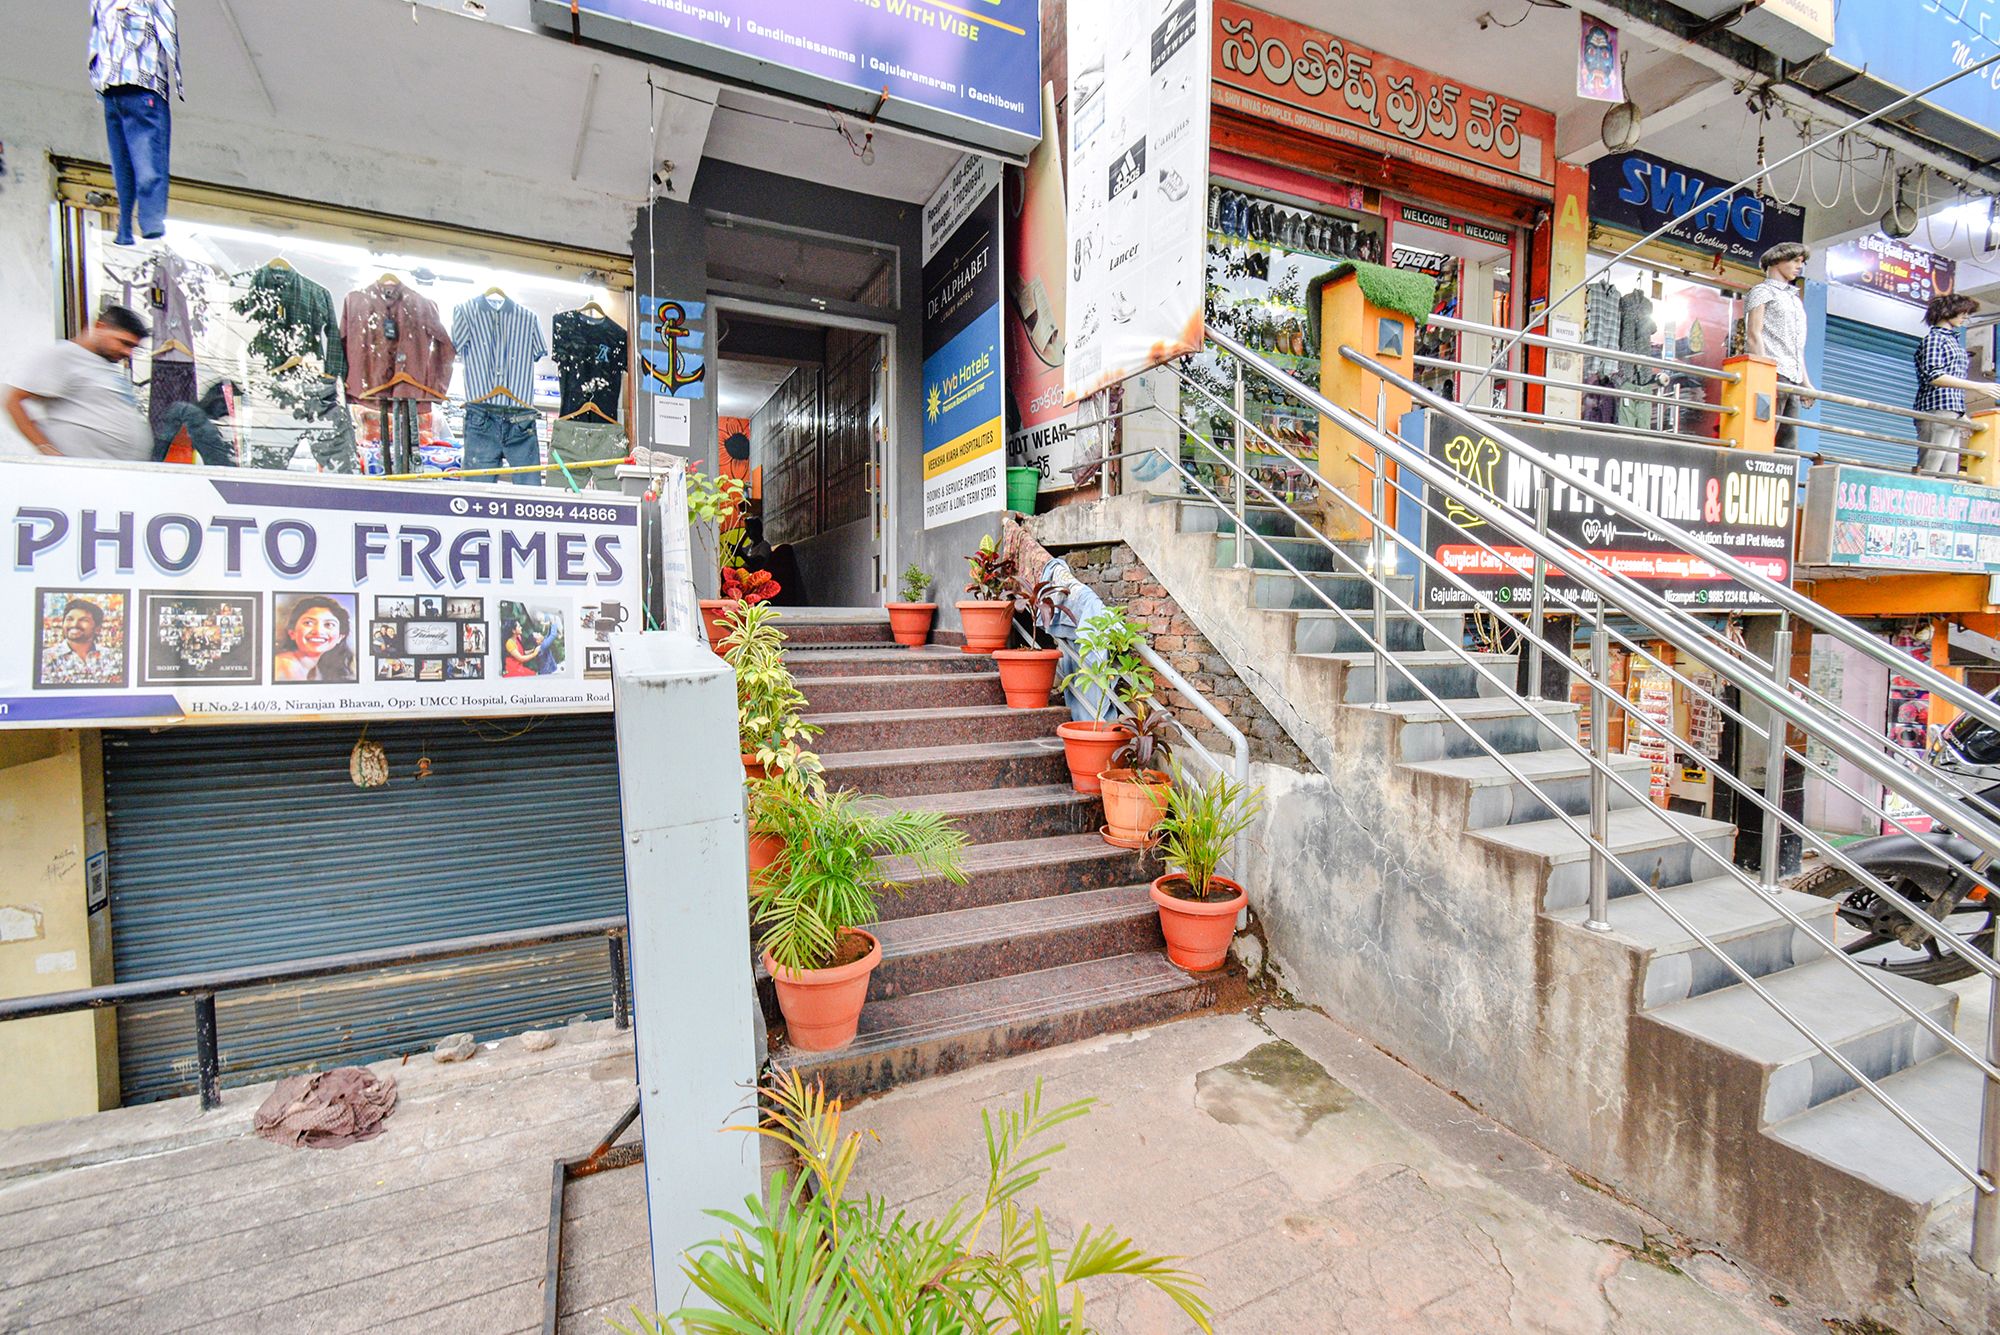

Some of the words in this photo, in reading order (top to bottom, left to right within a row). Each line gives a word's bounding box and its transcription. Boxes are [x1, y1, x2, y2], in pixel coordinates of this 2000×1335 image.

[934, 11, 980, 42] VIBE
[1151, 21, 1196, 72] FOOTWEAR
[746, 20, 856, 63] Gandimaissamma
[869, 57, 957, 93] Gajularamaram
[968, 87, 1025, 114] Gachibowli
[1153, 118, 1191, 151] Campus
[1618, 157, 1765, 243] SWAG
[1403, 208, 1449, 229] WELCOME
[1465, 224, 1508, 244] WELCOME
[1109, 243, 1140, 272] Lancer
[1392, 249, 1449, 270] sparx
[1694, 232, 1728, 253] Clothing
[1730, 243, 1754, 258] Store
[928, 296, 939, 320] DE
[941, 246, 990, 308] ALPHABET
[959, 352, 990, 386] Hotels
[960, 430, 994, 457] HOSPITALITIES
[1005, 435, 1029, 458] OOT
[1032, 423, 1069, 450] WEAR
[945, 479, 964, 496] SERVICE
[964, 466, 997, 488] APARTMENTS
[1754, 460, 1774, 474] 77022
[926, 505, 935, 517] FOR
[935, 500, 949, 515] SHORT
[954, 495, 966, 510] LONG
[966, 490, 980, 504] TERM
[981, 484, 997, 501] STAYS
[1603, 458, 1701, 522] CENTRAL
[1705, 478, 1722, 523] &
[1725, 472, 1790, 528] CLINIC
[488, 502, 509, 516] 91
[514, 503, 564, 519] 80994
[569, 506, 617, 522] 44866
[14, 506, 317, 579] PHOTO
[352, 520, 624, 589] FRAMES
[1723, 533, 1735, 544] for
[1735, 533, 1746, 545] all
[1746, 534, 1760, 547] Pet
[1761, 535, 1785, 548] Needs
[1443, 550, 1479, 571] Surgical
[285, 699, 335, 711] Niranjan
[339, 698, 384, 709] Bhavan,
[388, 697, 416, 709] Opp:
[420, 696, 458, 706] UMCC
[461, 694, 507, 707] Hospital,
[510, 693, 583, 704] Gajularamaram
[586, 692, 610, 702] Road
